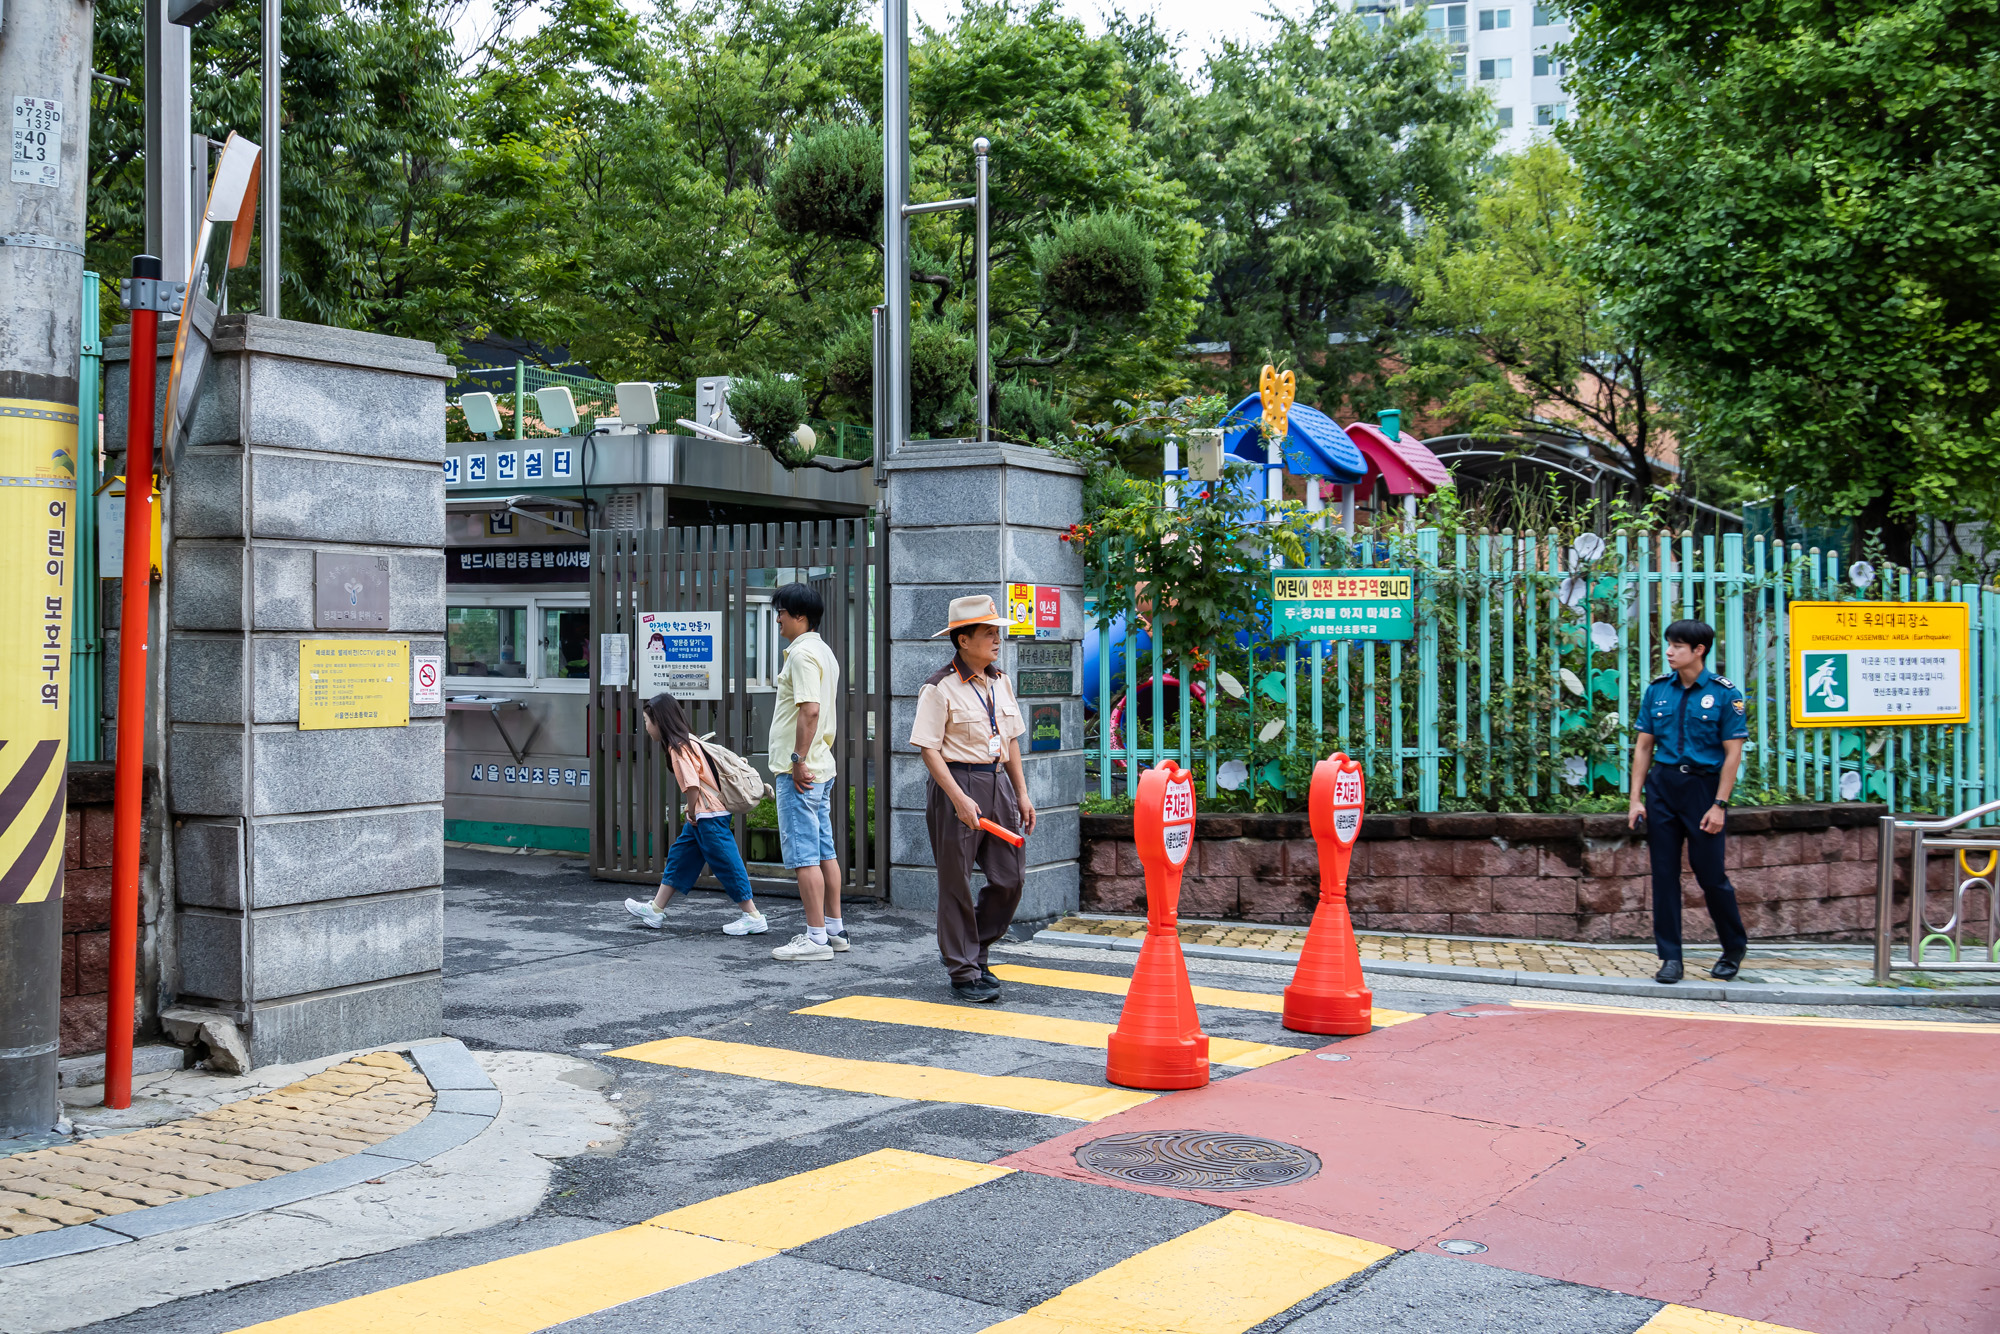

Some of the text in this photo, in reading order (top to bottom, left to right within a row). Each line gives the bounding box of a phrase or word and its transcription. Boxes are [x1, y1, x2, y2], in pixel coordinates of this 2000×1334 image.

[16, 106, 60, 121] 9729D
[26, 118, 51, 130] 132
[24, 130, 47, 146] 40
[23, 145, 46, 161] L3
[47, 501, 66, 587] 어린이
[1277, 580, 1308, 598] 어린이
[1312, 579, 1333, 598] 안전
[1040, 601, 1057, 615] 에스원
[1340, 607, 1363, 619] 하지
[1367, 606, 1401, 619] 마세요
[649, 621, 711, 633] 안전한 학교 만들기
[1836, 612, 1929, 628] 지진 옥외대피장소
[1310, 625, 1377, 635] 서울연신초등학교
[1811, 634, 1853, 642] EMERGENCY
[1911, 634, 1951, 642] (Earthquake)
[42, 596, 62, 710] 보호구역
